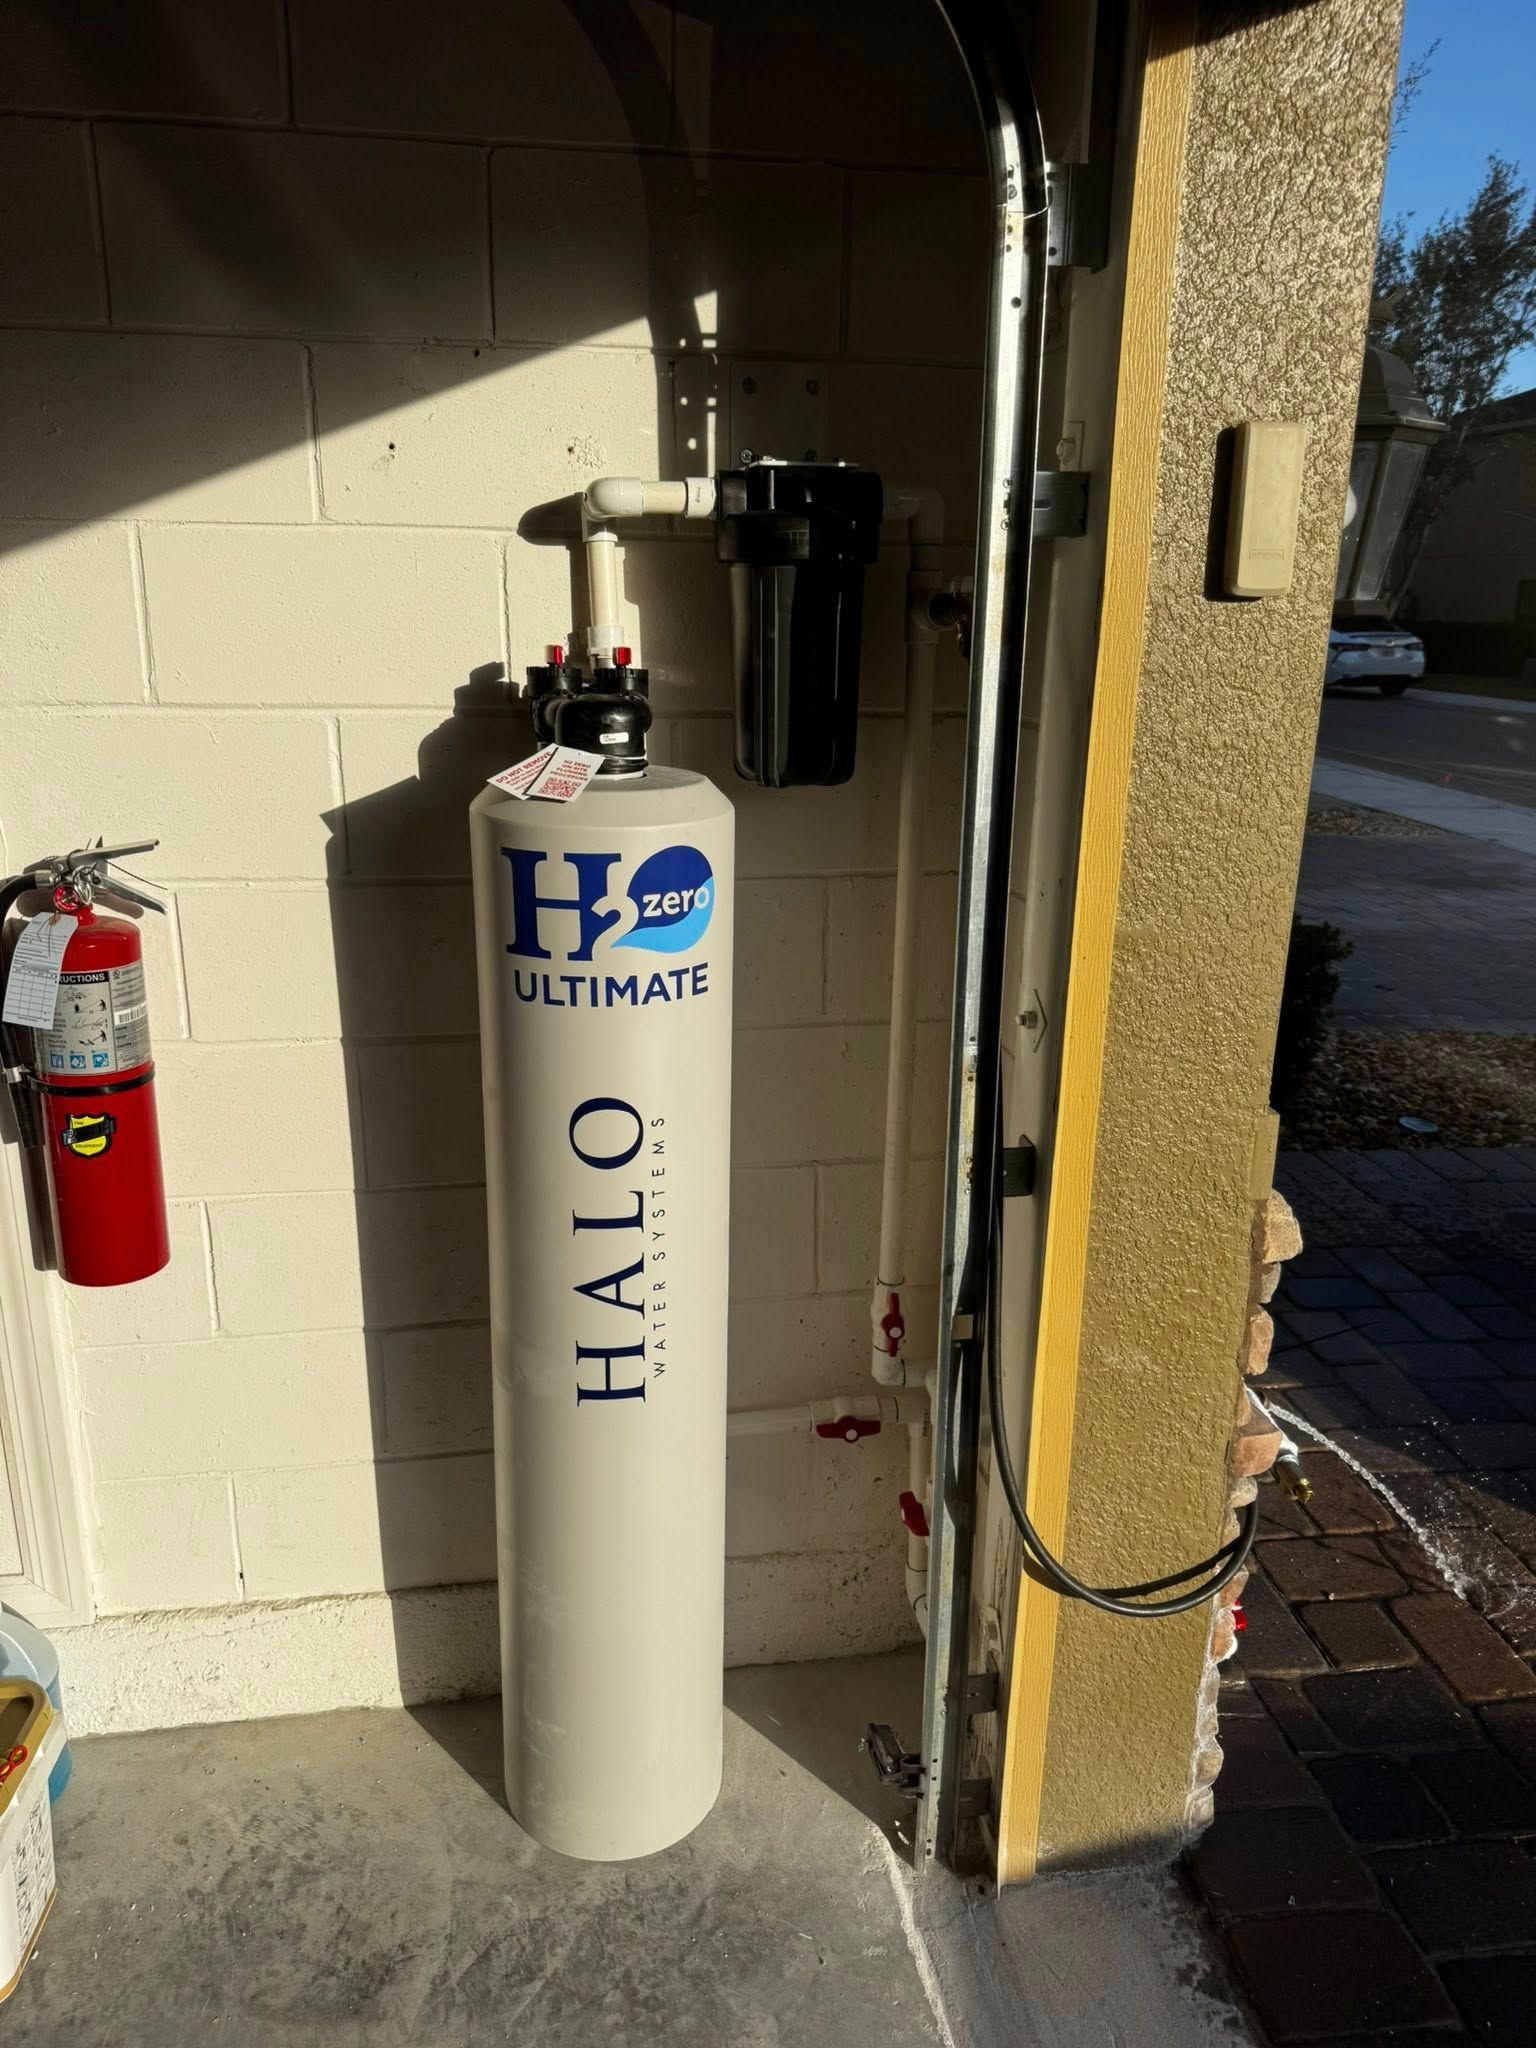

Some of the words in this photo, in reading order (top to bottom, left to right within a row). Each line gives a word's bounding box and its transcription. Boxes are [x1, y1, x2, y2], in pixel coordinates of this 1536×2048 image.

[495, 775, 509, 784] DO
[507, 767, 523, 778] NOT
[522, 752, 551, 769] REMOVE
[643, 887, 710, 918] zero
[514, 962, 709, 1008] ULTIMATE
[651, 1118, 666, 1261] SYSTEMS
[569, 1097, 646, 1407] HALO
[653, 1281, 667, 1379] WATER
